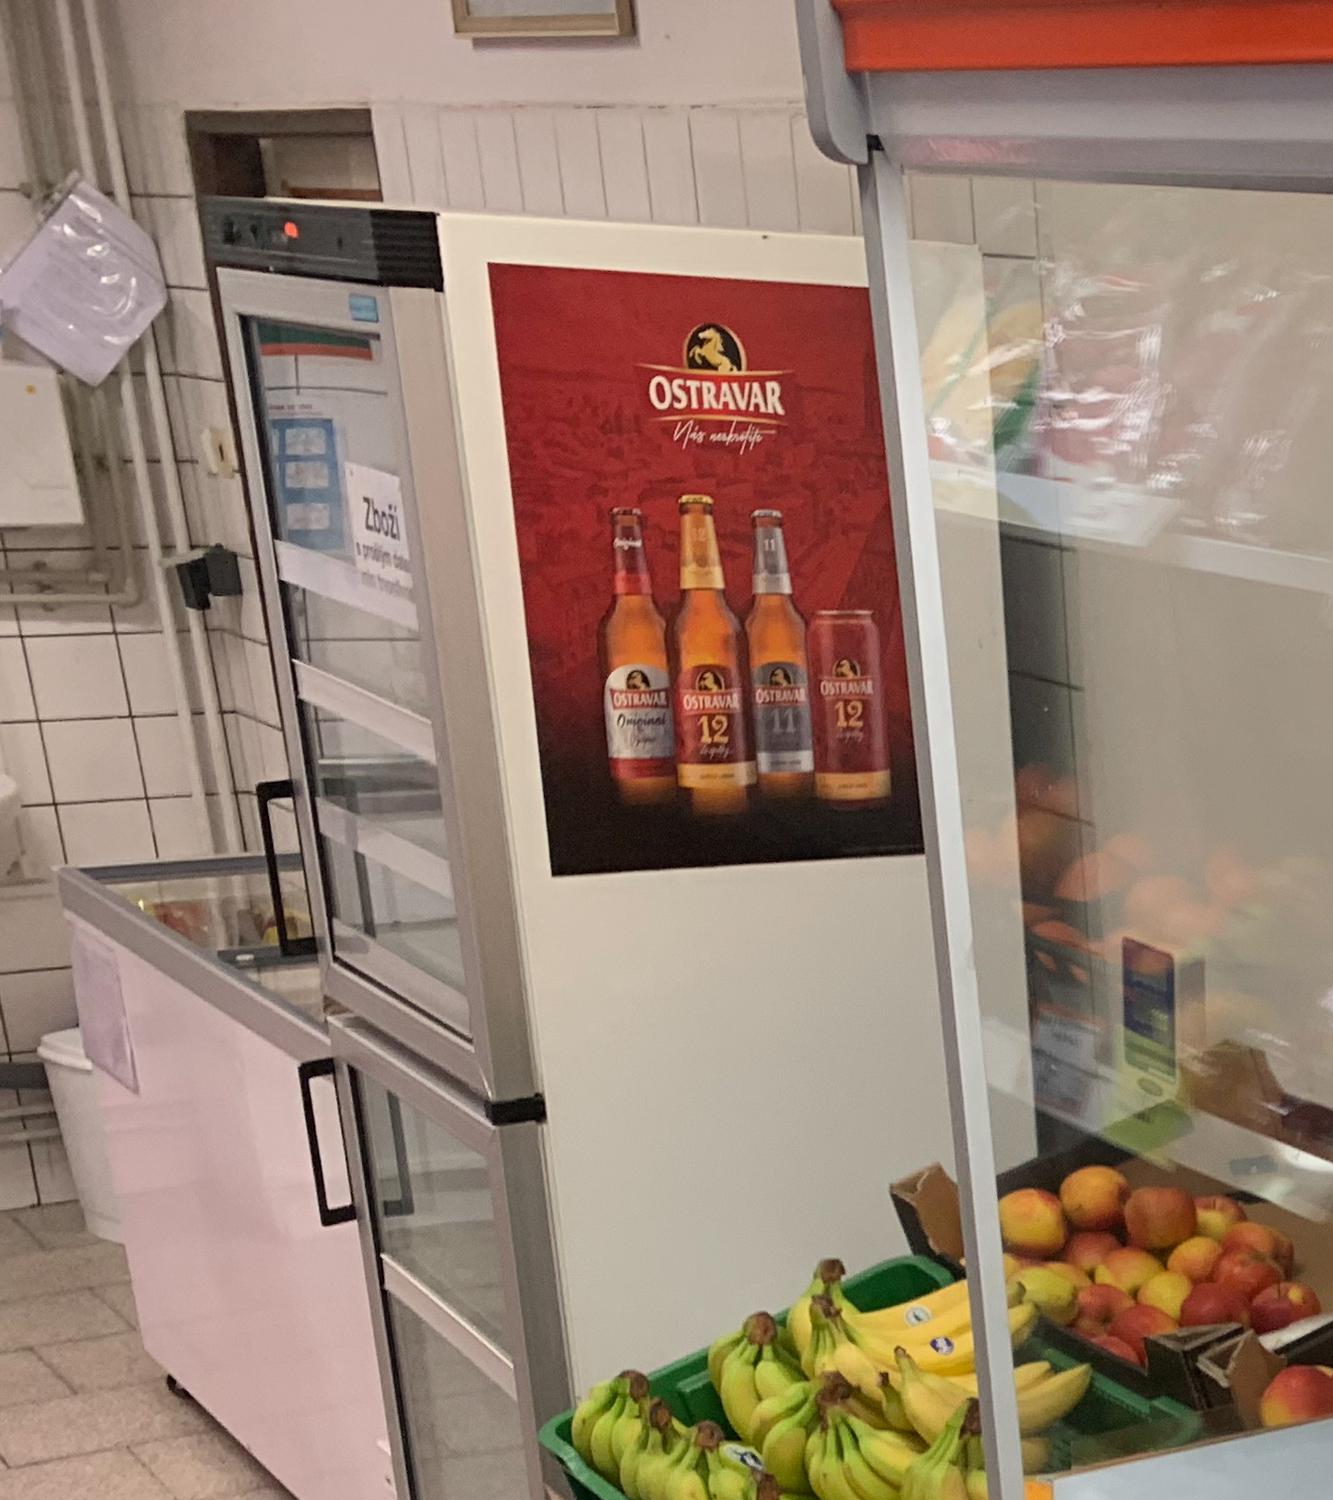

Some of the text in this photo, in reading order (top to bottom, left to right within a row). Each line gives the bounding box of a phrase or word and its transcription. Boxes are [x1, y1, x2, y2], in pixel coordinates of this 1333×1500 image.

[649, 375, 785, 416] OSTRAVAR
[363, 496, 400, 541] Zboží
[763, 538, 776, 551] 11
[613, 691, 667, 707] OSTRAVAR
[820, 680, 874, 696] OSTRAVAR
[683, 694, 740, 710] OSTRAVAR
[835, 700, 864, 728] 12
[697, 715, 729, 744] 12
[770, 708, 796, 733] 11
